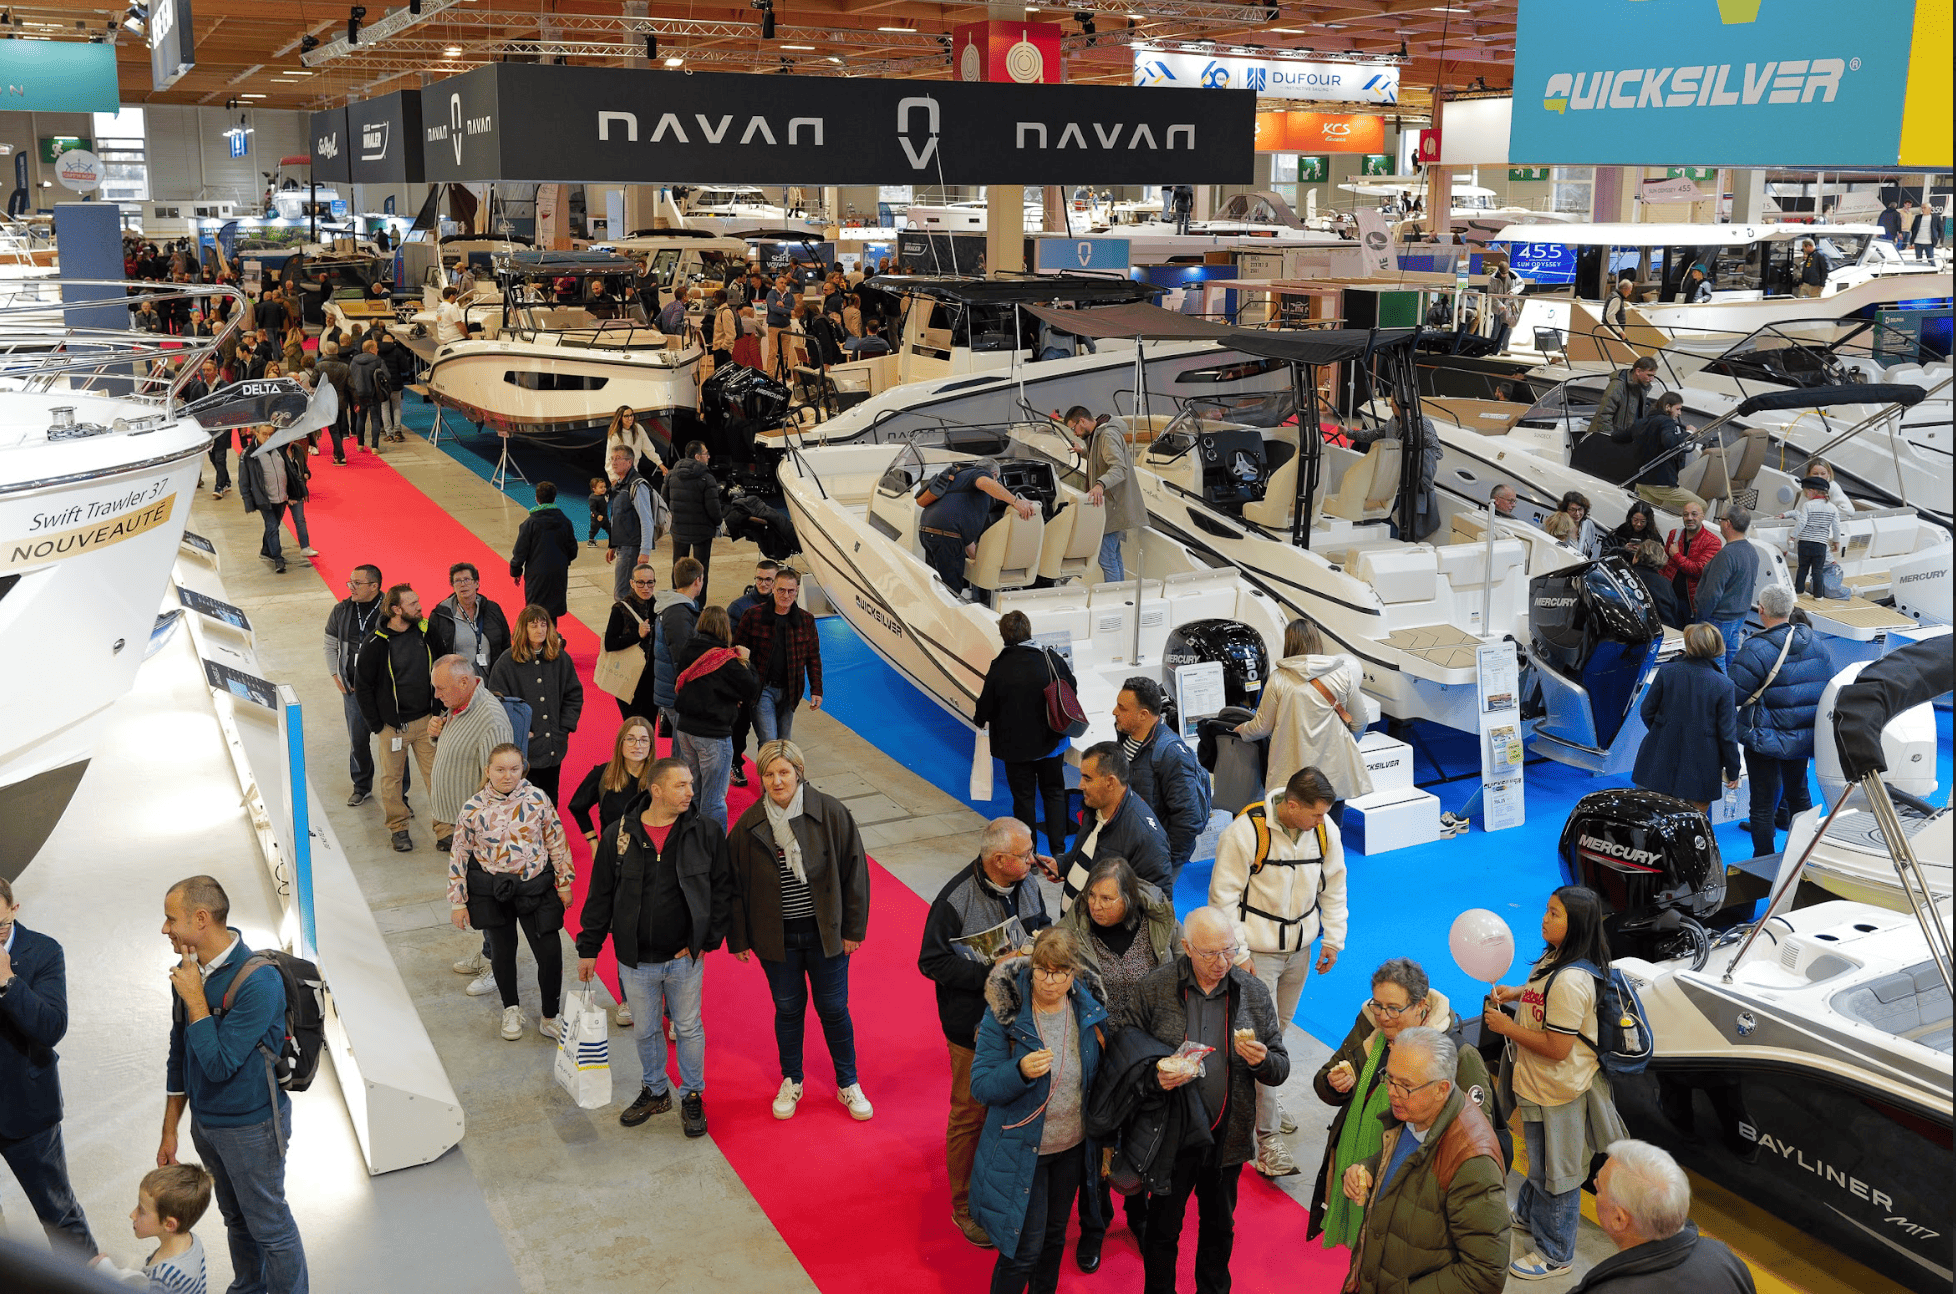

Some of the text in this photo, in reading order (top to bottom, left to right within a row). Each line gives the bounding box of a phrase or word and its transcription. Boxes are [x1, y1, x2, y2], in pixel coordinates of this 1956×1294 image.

[1272, 72, 1341, 86] DUFOUR
[598, 110, 824, 146] NAVAN
[1016, 121, 1196, 150] NAVAN
[1677, 184, 1692, 192] 455
[1518, 244, 1562, 259] 455
[242, 383, 282, 396] DELTA
[755, 387, 786, 401] MERCURY
[29, 477, 169, 531] Swift Trawler 37
[10, 501, 166, 563] NOUVEAUTÉ
[1618, 568, 1645, 601] 300
[1899, 569, 1949, 584] MERCURY
[1534, 597, 1578, 607] MERCURY
[855, 594, 903, 639] QUICKSILVER
[1164, 654, 1201, 665] MERCURY
[1243, 647, 1259, 681] 150
[1366, 758, 1400, 771] KSILVER
[1579, 833, 1663, 866] MERCURY
[1738, 1120, 1893, 1213] BAYLINER
